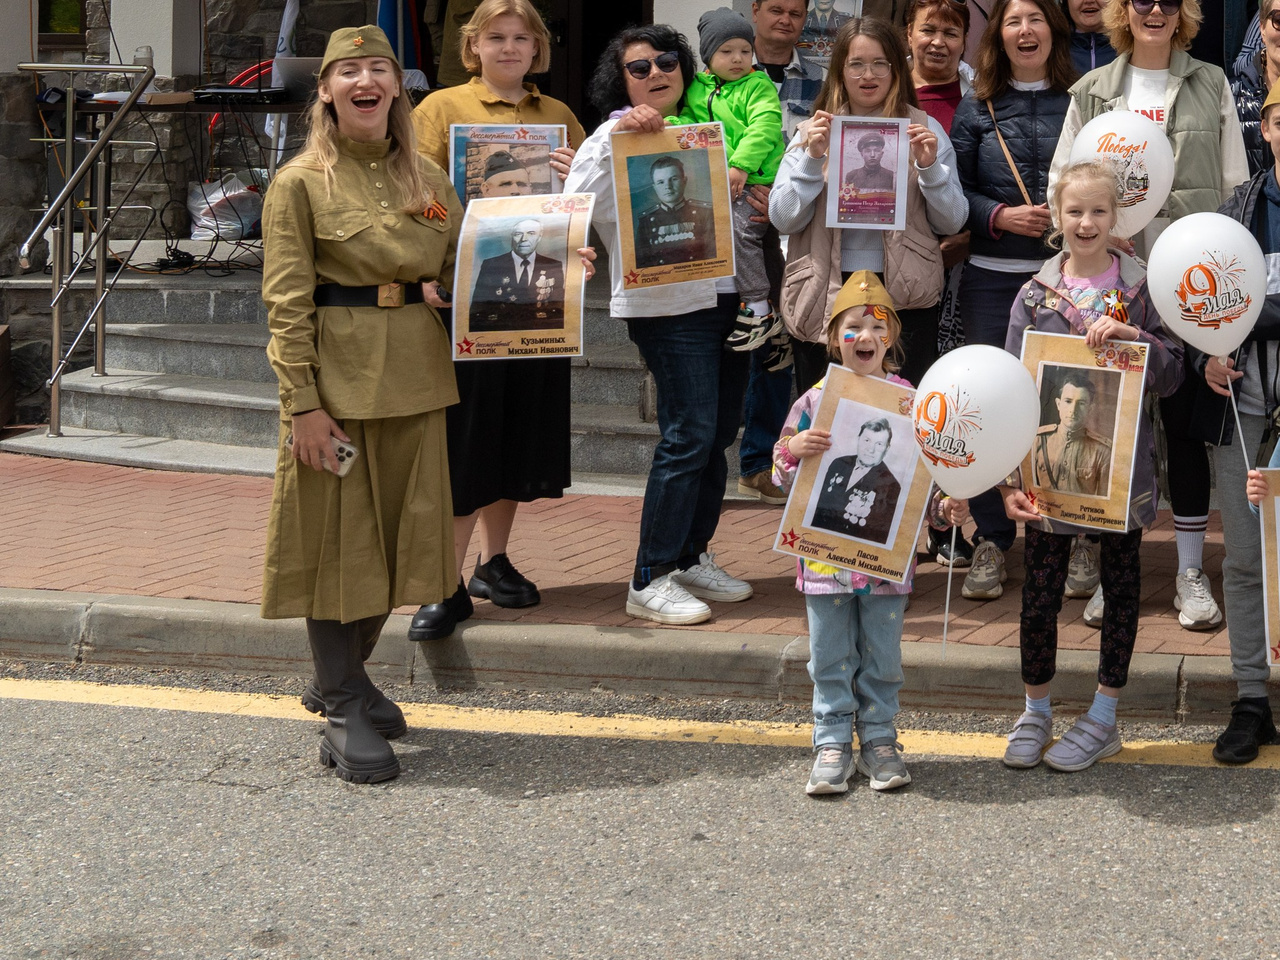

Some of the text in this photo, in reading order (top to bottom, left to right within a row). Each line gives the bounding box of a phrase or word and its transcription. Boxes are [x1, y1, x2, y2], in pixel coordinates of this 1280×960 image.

[698, 132, 708, 148] 9
[1097, 132, 1148, 158] Победа!
[1182, 264, 1217, 297] 9
[521, 337, 566, 346] Кузьминых
[540, 346, 579, 354] Иванович
[1118, 351, 1129, 371] 9
[922, 391, 948, 434] 9
[1060, 510, 1126, 526] Дмитрий Дмитриевич
[1080, 505, 1105, 515] Ретивов
[857, 550, 879, 562] Пасов
[826, 552, 904, 578] Алексей Михайлович
